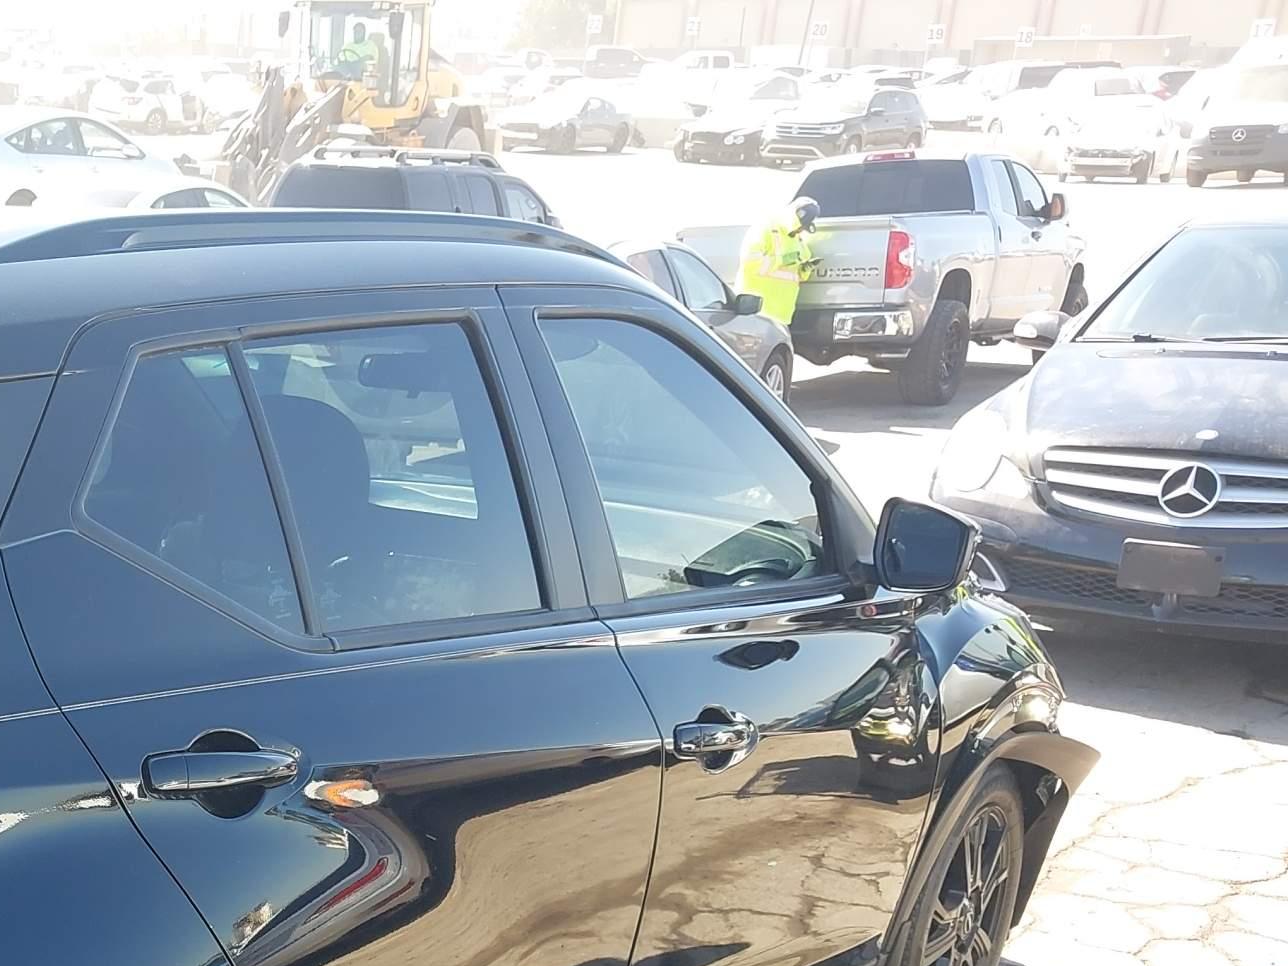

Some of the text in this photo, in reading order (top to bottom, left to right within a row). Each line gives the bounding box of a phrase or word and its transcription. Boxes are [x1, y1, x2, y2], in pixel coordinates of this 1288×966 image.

[812, 23, 828, 36] 20
[928, 28, 944, 40] 19
[1252, 23, 1274, 38] 17
[1017, 31, 1033, 44] 18
[812, 266, 880, 278] UNDRA
